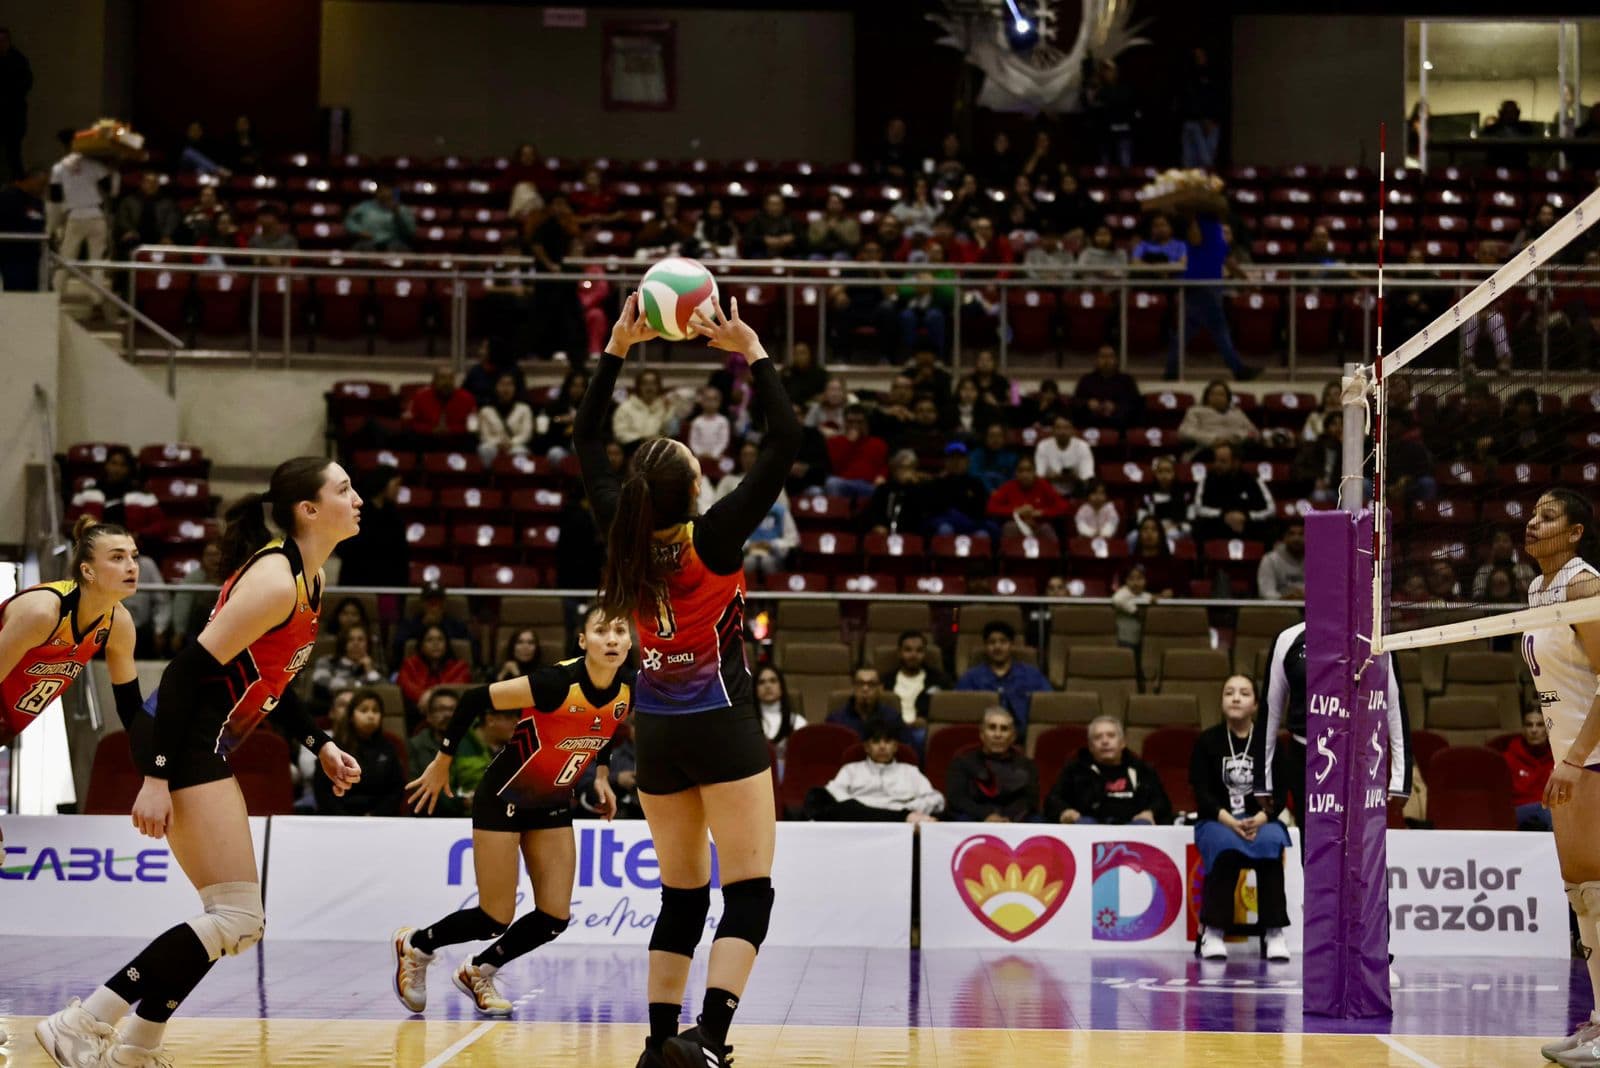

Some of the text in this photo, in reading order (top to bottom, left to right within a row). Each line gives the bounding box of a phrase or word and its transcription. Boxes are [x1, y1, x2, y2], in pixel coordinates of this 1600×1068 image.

[14, 678, 64, 716] 19
[554, 751, 590, 786] 6
[0, 846, 169, 883] CABLE
[1417, 859, 1522, 891] valor
[1387, 891, 1539, 933] razón!
